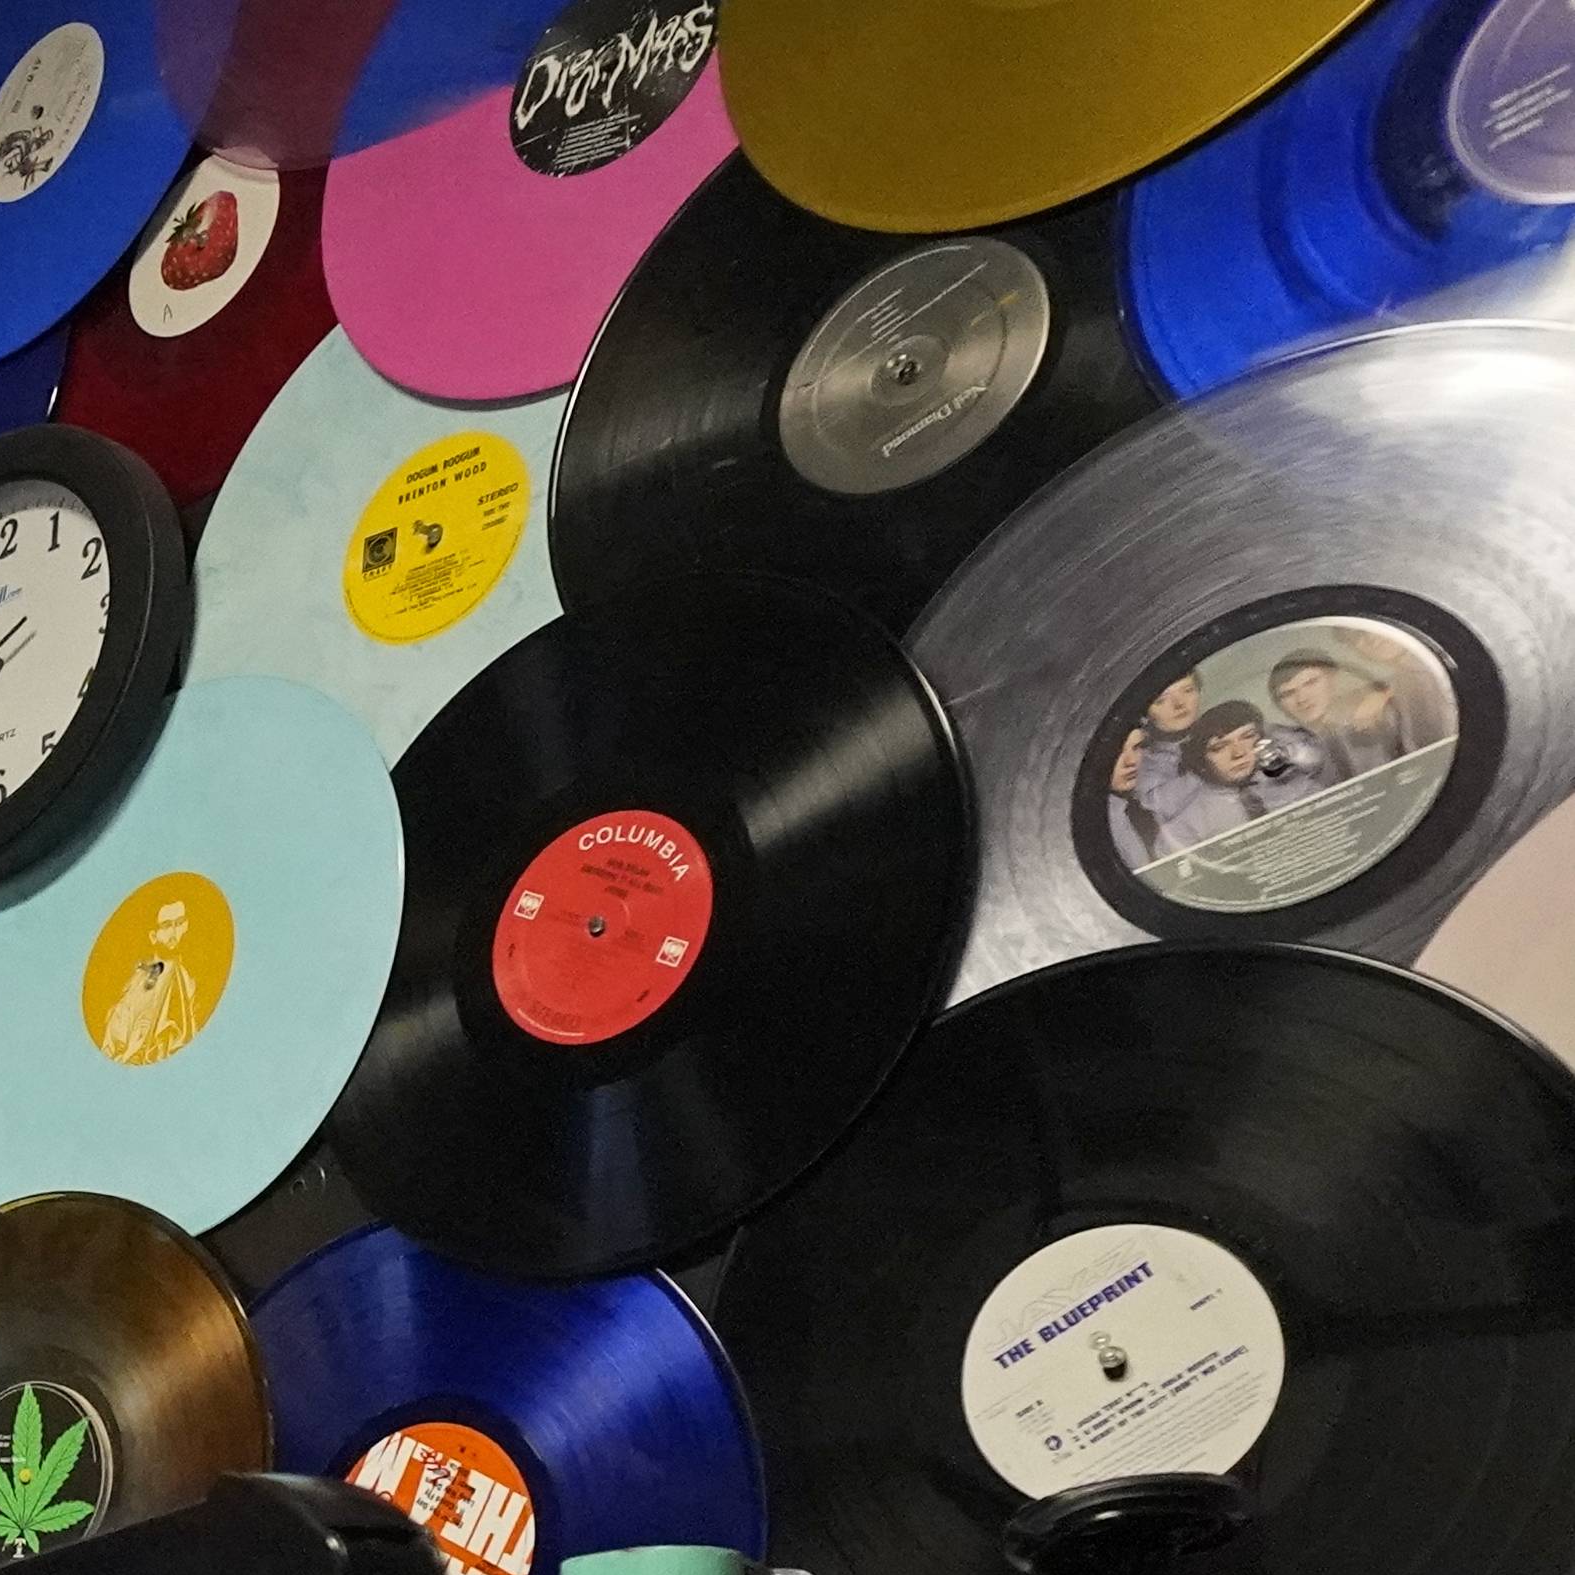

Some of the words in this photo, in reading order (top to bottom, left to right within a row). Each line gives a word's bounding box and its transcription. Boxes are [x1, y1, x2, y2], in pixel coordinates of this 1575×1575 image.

[452, 460, 489, 482] WOOD
[47, 510, 61, 553] 1
[80, 536, 103, 581] 2
[578, 824, 691, 882] COLUMBIA
[993, 1337, 1036, 1371] THE
[1037, 1261, 1154, 1343] BLUEPRINT
[440, 1468, 535, 1575] THE
